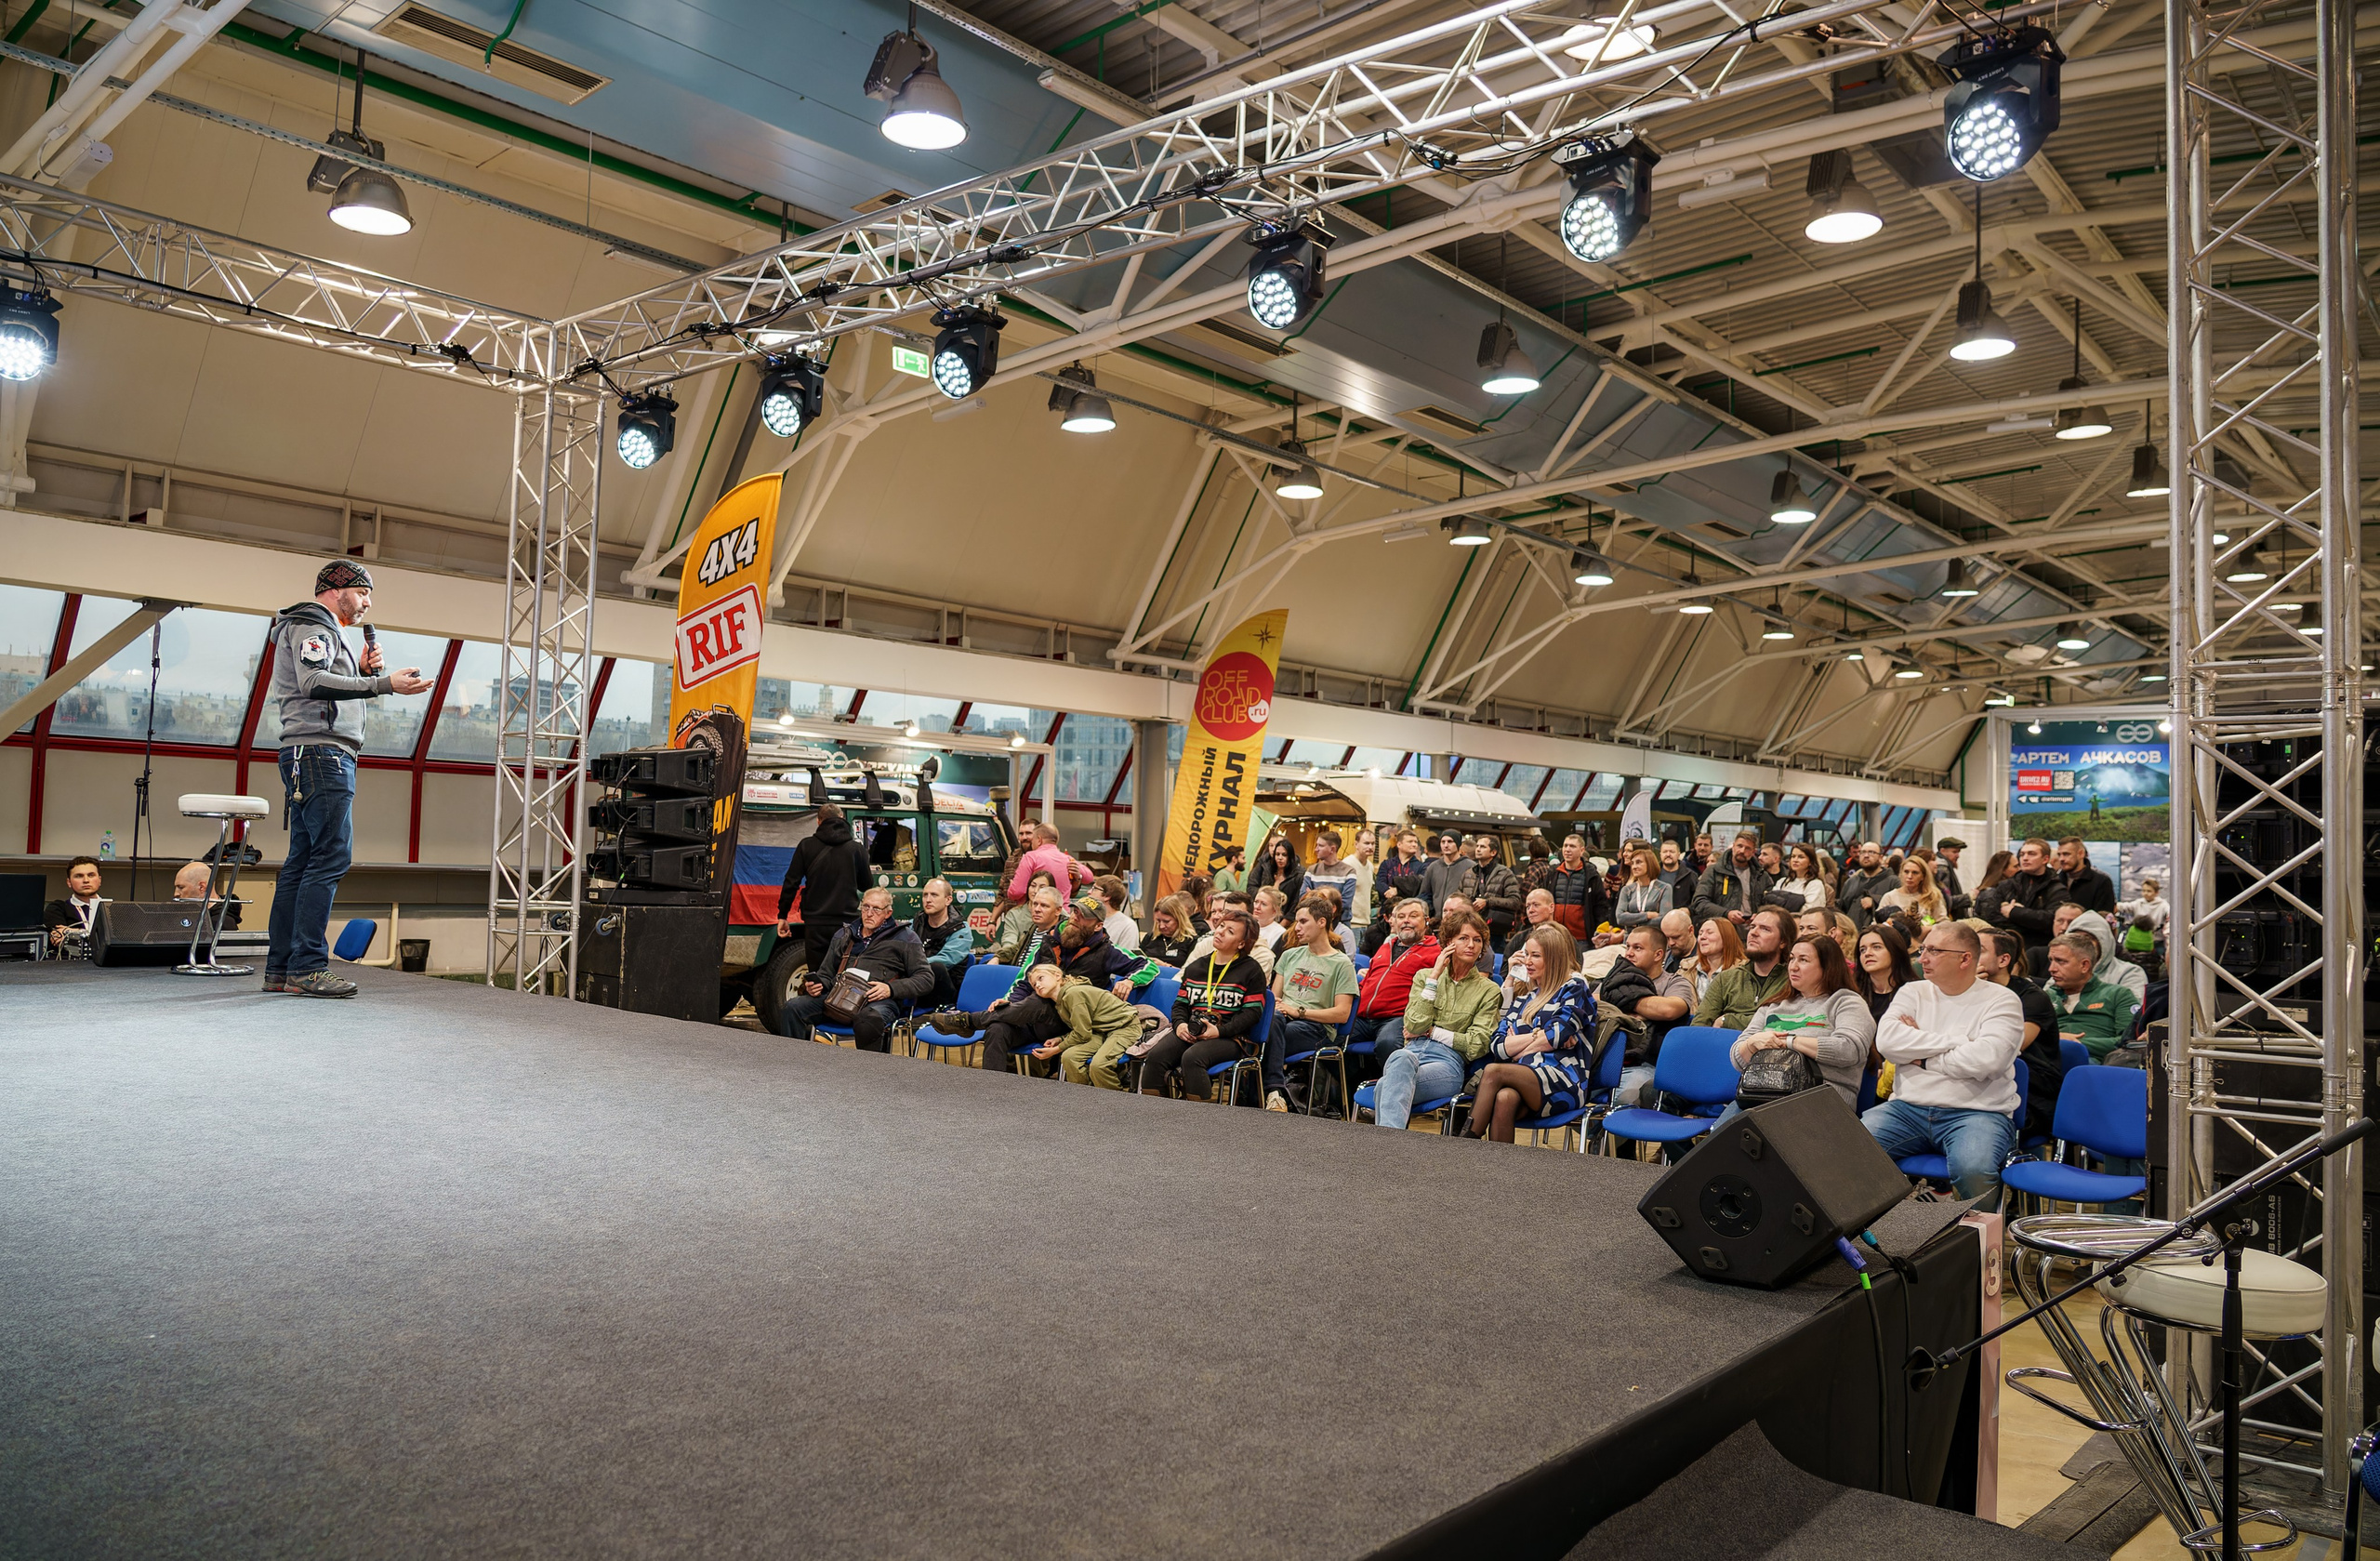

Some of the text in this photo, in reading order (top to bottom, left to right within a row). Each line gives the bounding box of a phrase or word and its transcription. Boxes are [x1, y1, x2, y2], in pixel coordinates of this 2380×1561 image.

[698, 517, 760, 588] 4X4
[686, 602, 747, 673] RIF
[1206, 669, 1249, 690] OFF
[1202, 686, 1262, 707] ROAD
[1200, 704, 1267, 724] CLUB .ru
[2016, 750, 2162, 764] АРТЕМ АЧКАСОВ
[712, 792, 736, 836] AN
[1182, 747, 1217, 879] НЕДОРОЖНЫЙ
[969, 915, 990, 928] RE
